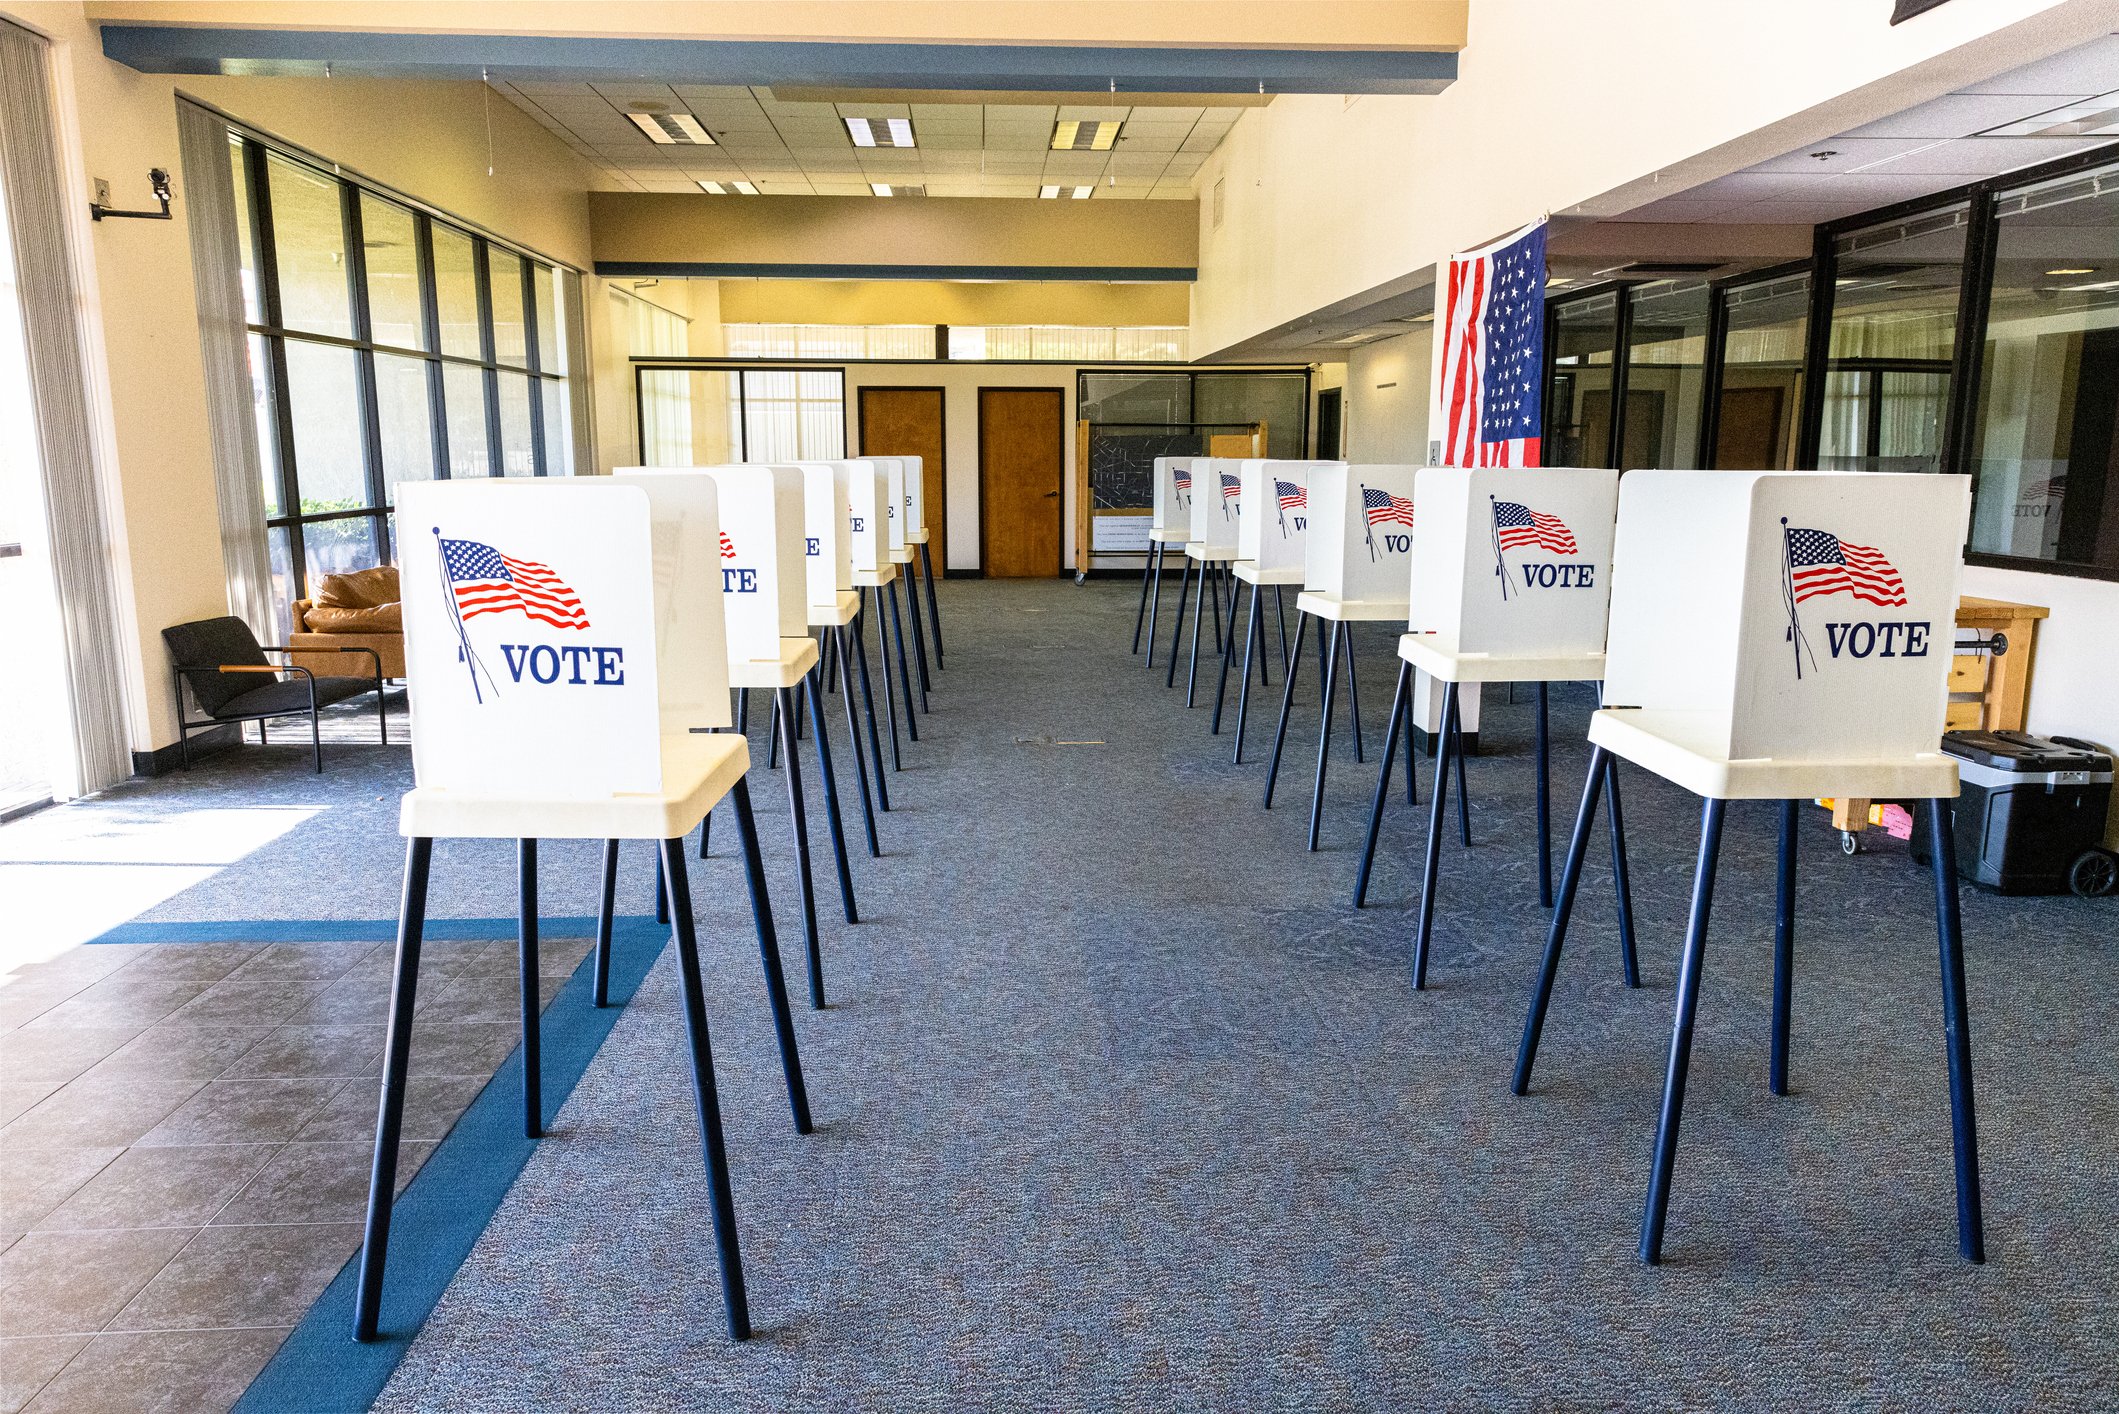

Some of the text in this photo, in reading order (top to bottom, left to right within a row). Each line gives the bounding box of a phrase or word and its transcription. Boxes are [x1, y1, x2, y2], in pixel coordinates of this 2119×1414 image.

[1384, 534, 1411, 554] VO
[721, 568, 757, 594] TE
[1521, 563, 1595, 589] VOTE
[1825, 621, 1931, 659] VOTE
[500, 644, 626, 686] VOTE
